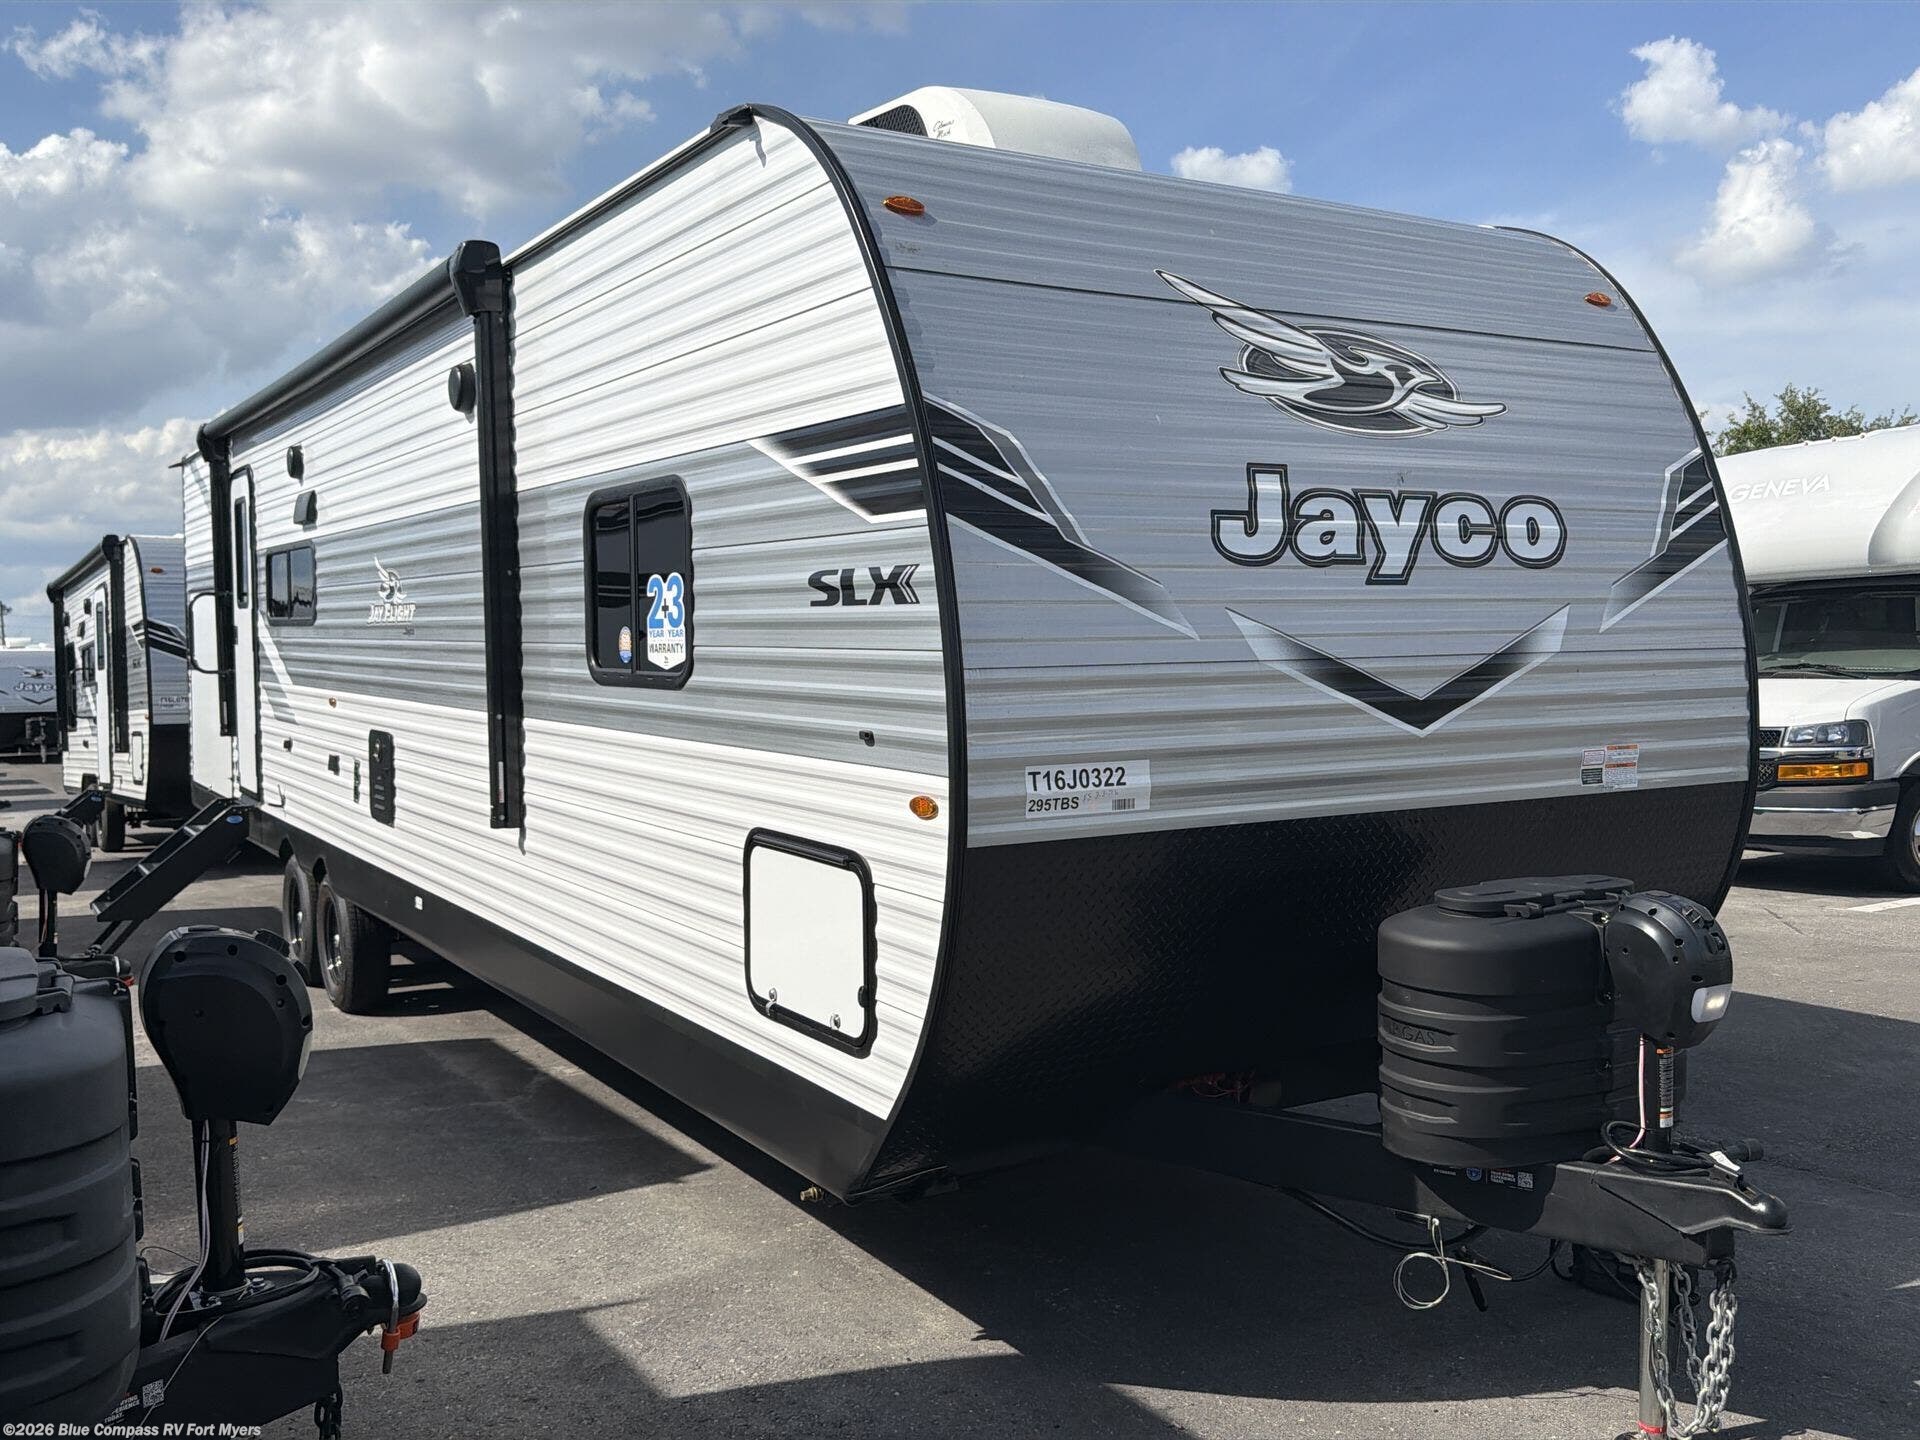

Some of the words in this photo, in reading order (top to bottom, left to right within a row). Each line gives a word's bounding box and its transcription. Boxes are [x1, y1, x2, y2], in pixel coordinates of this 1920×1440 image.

[1727, 473, 1831, 504] GENEVA
[1210, 462, 1567, 585] Jayco
[367, 604, 385, 625] JAY
[384, 602, 416, 624] FLIGHT
[649, 629, 664, 637] YEAR
[668, 628, 684, 637] YEAR
[649, 643, 684, 653] WARRANTY
[1027, 766, 1127, 792] T16J0322
[1028, 796, 1080, 812] 295TBS
